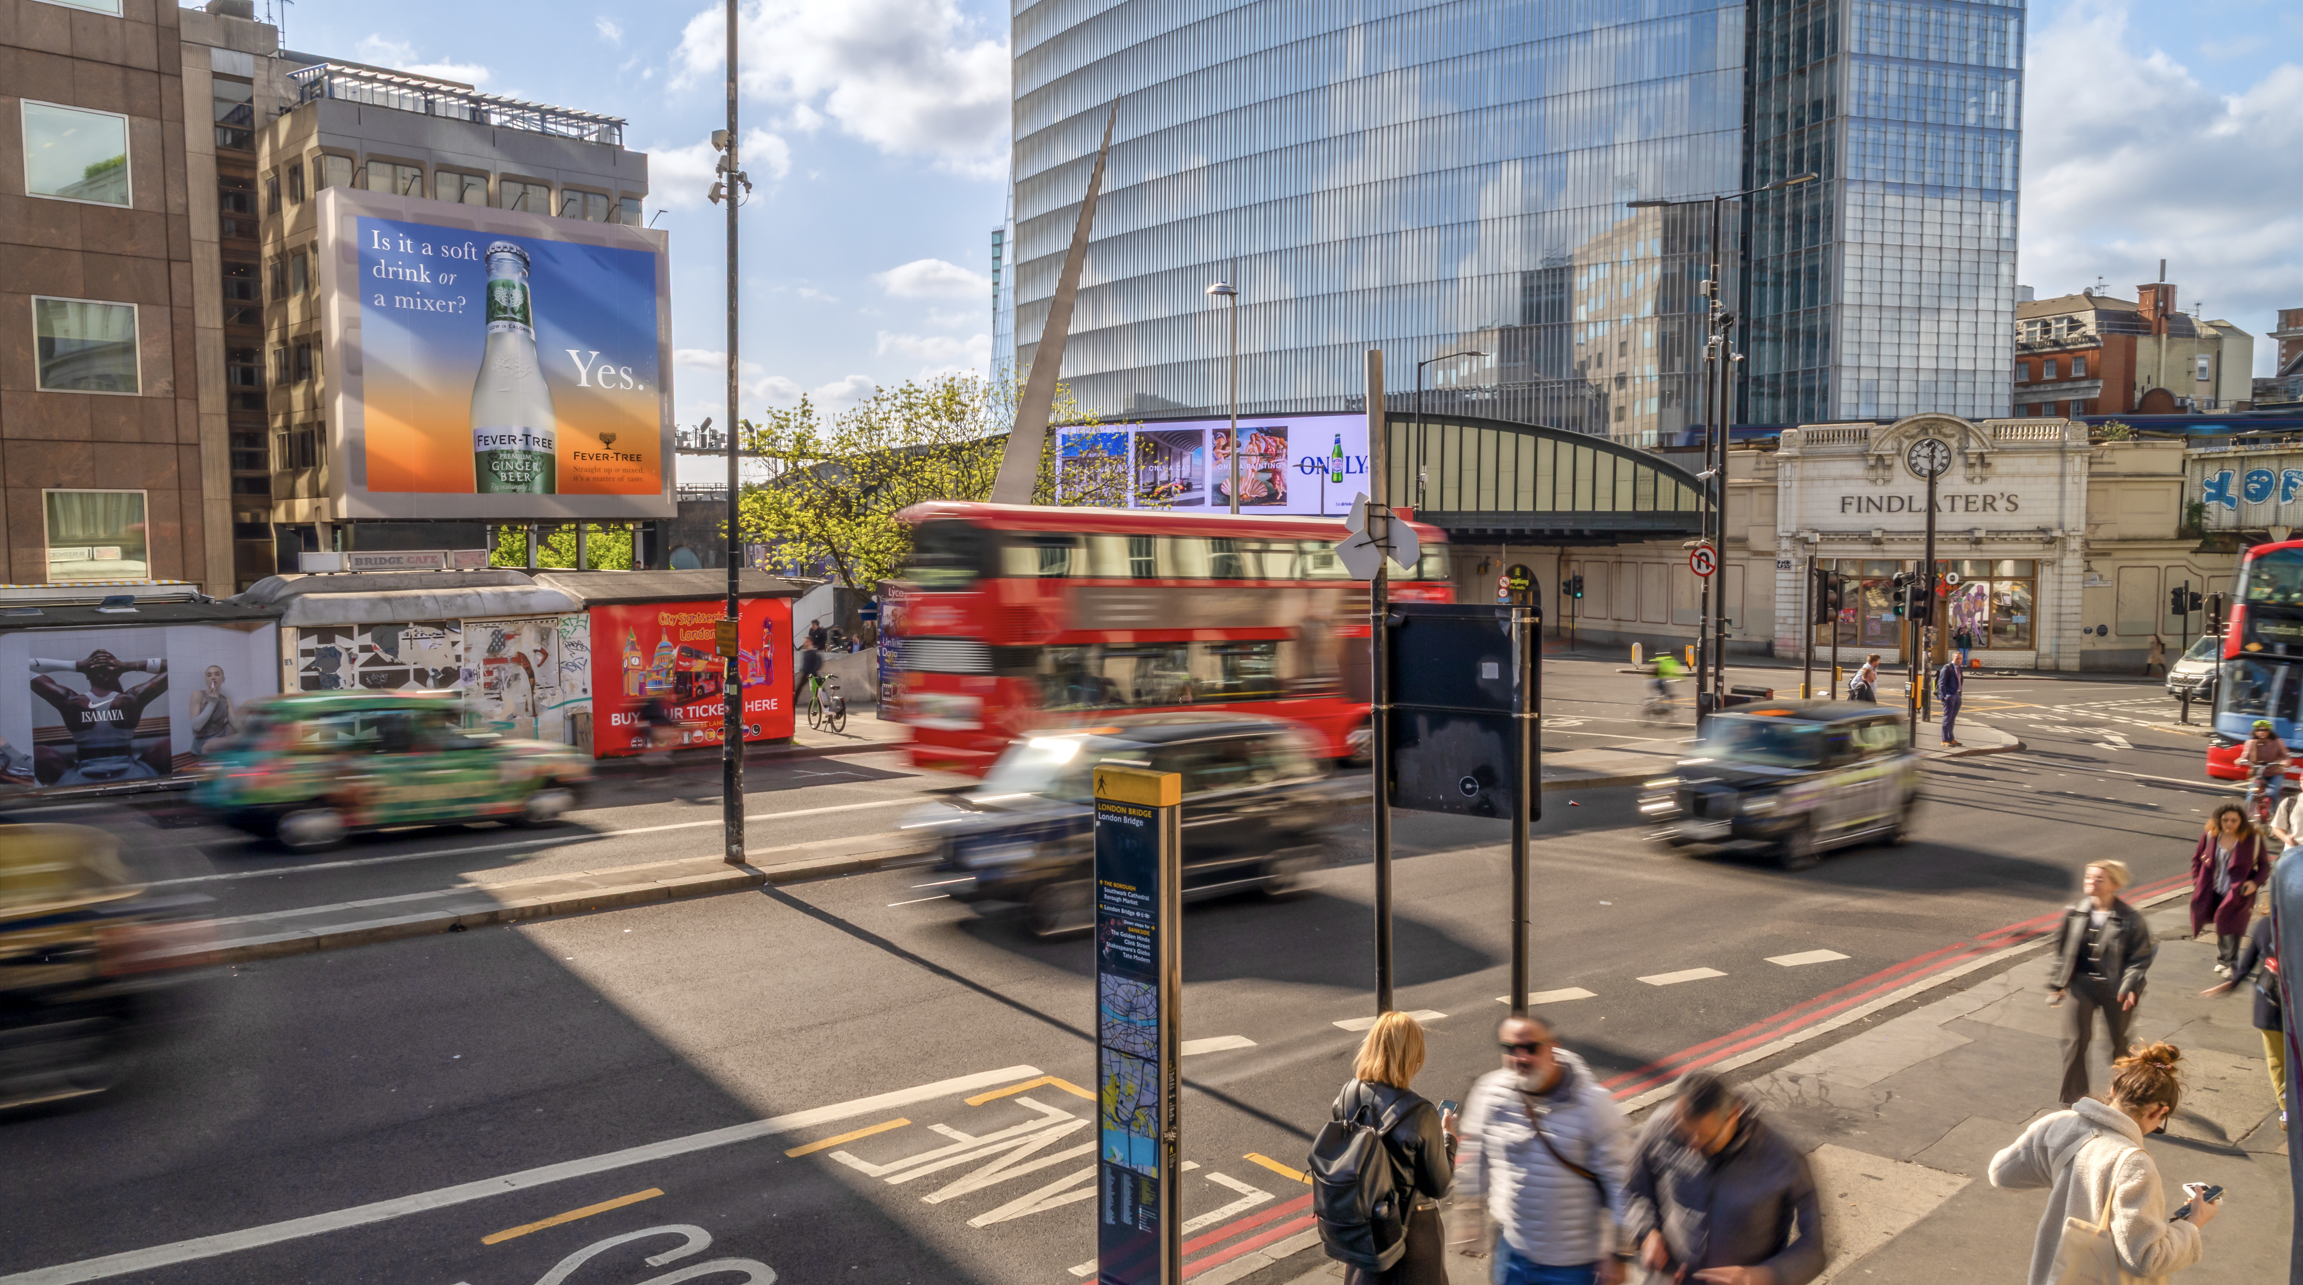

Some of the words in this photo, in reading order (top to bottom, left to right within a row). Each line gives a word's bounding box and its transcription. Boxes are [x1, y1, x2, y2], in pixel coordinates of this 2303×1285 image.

[371, 229, 391, 251] Is
[398, 233, 414, 254] it
[421, 242, 434, 256] a
[441, 241, 478, 261] soft
[372, 259, 432, 284] drink
[438, 272, 457, 286] or
[374, 293, 387, 307] a
[394, 291, 467, 314] mixer?
[565, 349, 644, 391] Yes.
[477, 433, 553, 449] FEVER-TREE
[573, 451, 642, 462] FEVER-TREE
[491, 460, 540, 472] GINGER
[573, 465, 602, 474] Straight
[603, 467, 613, 475] up
[622, 466, 645, 474] mixed,
[1246, 462, 1282, 470] PAINTING
[500, 472, 532, 482] BEER
[573, 474, 584, 482] it's
[592, 474, 615, 482] matter
[617, 474, 625, 482] of
[627, 475, 645, 483] taste.
[354, 556, 404, 566] BRIDGE
[406, 555, 438, 565] CAFE
[658, 612, 678, 627] City
[678, 612, 726, 626] Sightseein
[81, 709, 125, 723] ISAMAYA
[611, 711, 641, 727] BUY
[687, 703, 725, 719] TICKE
[745, 698, 779, 713] HERE
[1098, 803, 1127, 815] LONDON
[1128, 807, 1152, 819] BRIDGE
[1098, 812, 1122, 823] London
[1123, 815, 1144, 827] Bridge
[1113, 882, 1136, 891] BOROUGH
[1104, 887, 1127, 897] Southwark
[1128, 891, 1150, 901] Cathedral
[1104, 894, 1122, 903] Borough
[1122, 897, 1138, 906] Market
[1104, 904, 1120, 913] London
[1121, 908, 1135, 917] Bridge
[1120, 931, 1136, 940] Golden
[1128, 926, 1150, 936] BANKSIDE
[1106, 941, 1136, 953] Shakespeare's
[1137, 949, 1150, 957] Globe
[1136, 941, 1150, 950] Street
[1122, 952, 1133, 960] Tate
[1133, 954, 1150, 963] Modern
